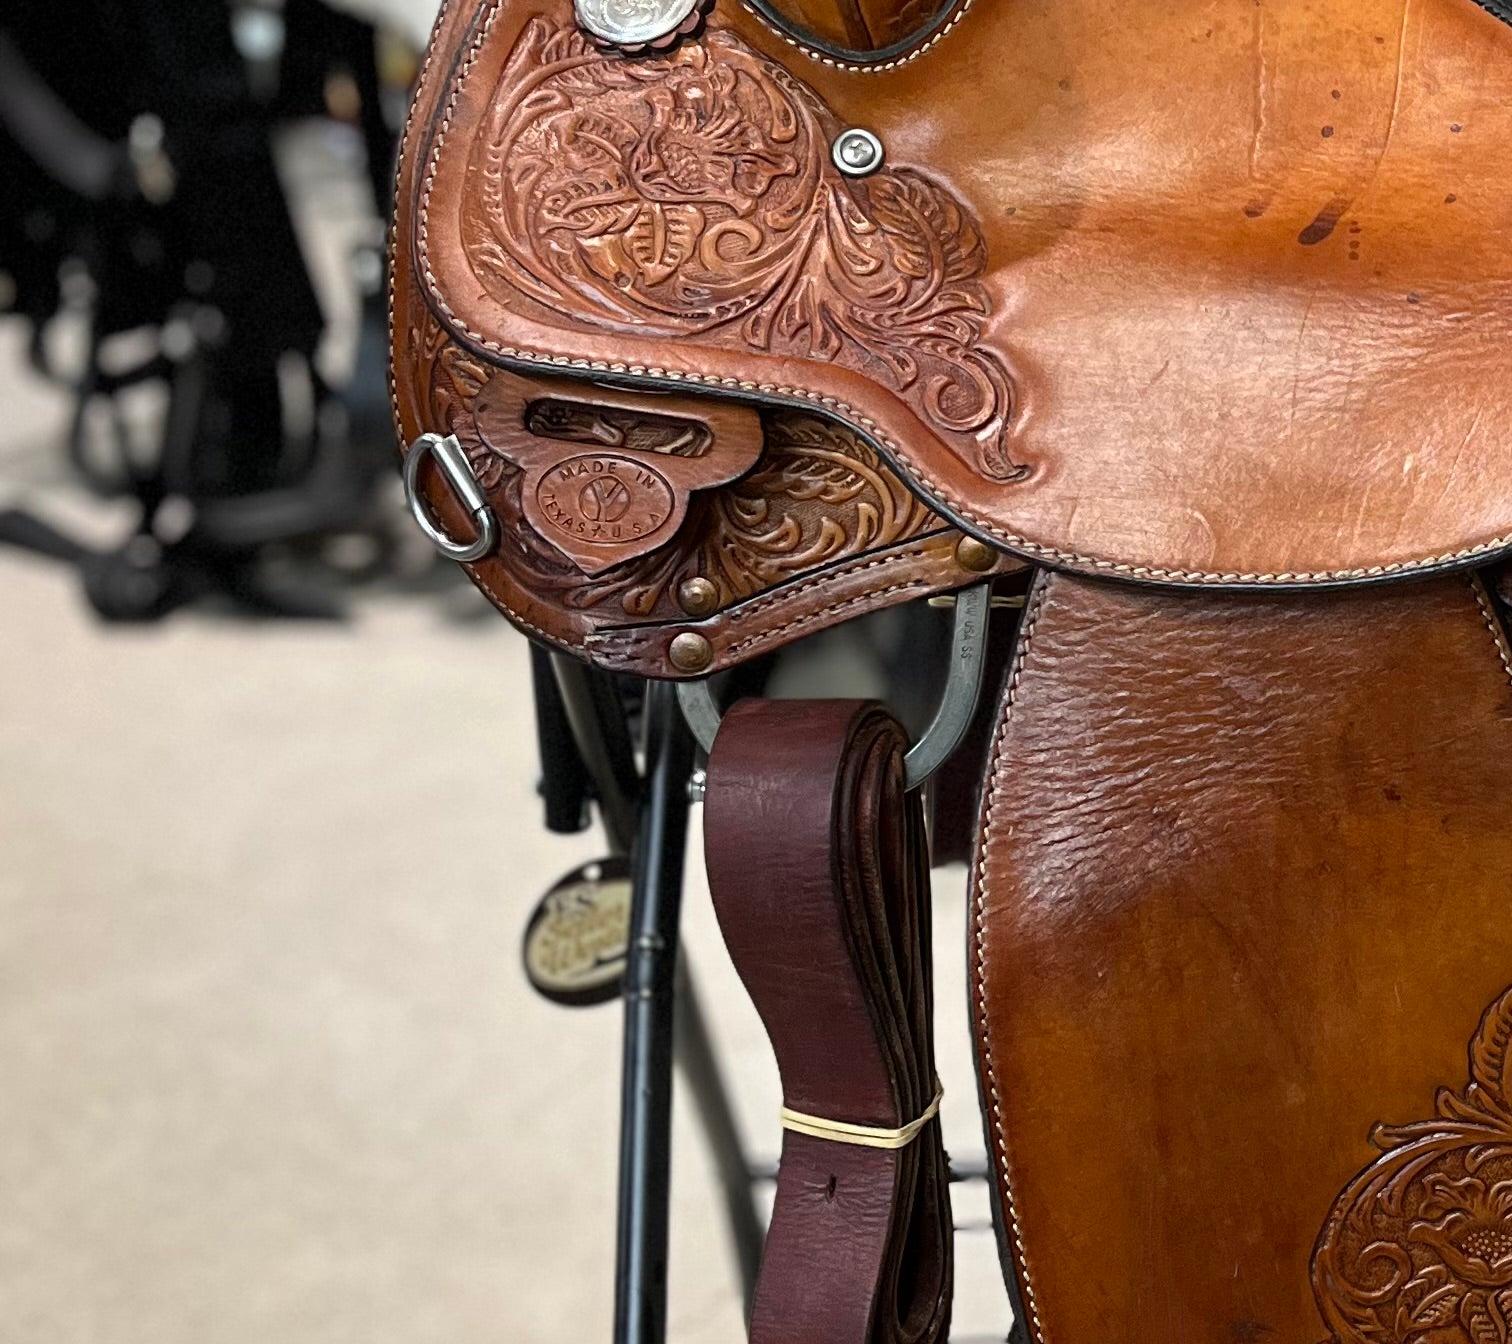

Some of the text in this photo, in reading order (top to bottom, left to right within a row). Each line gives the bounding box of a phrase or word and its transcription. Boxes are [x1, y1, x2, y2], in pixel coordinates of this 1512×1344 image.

[558, 461, 656, 489] MADE IN
[543, 494, 586, 533] TEXAS
[963, 621, 976, 641] USA
[960, 645, 973, 659] SS
